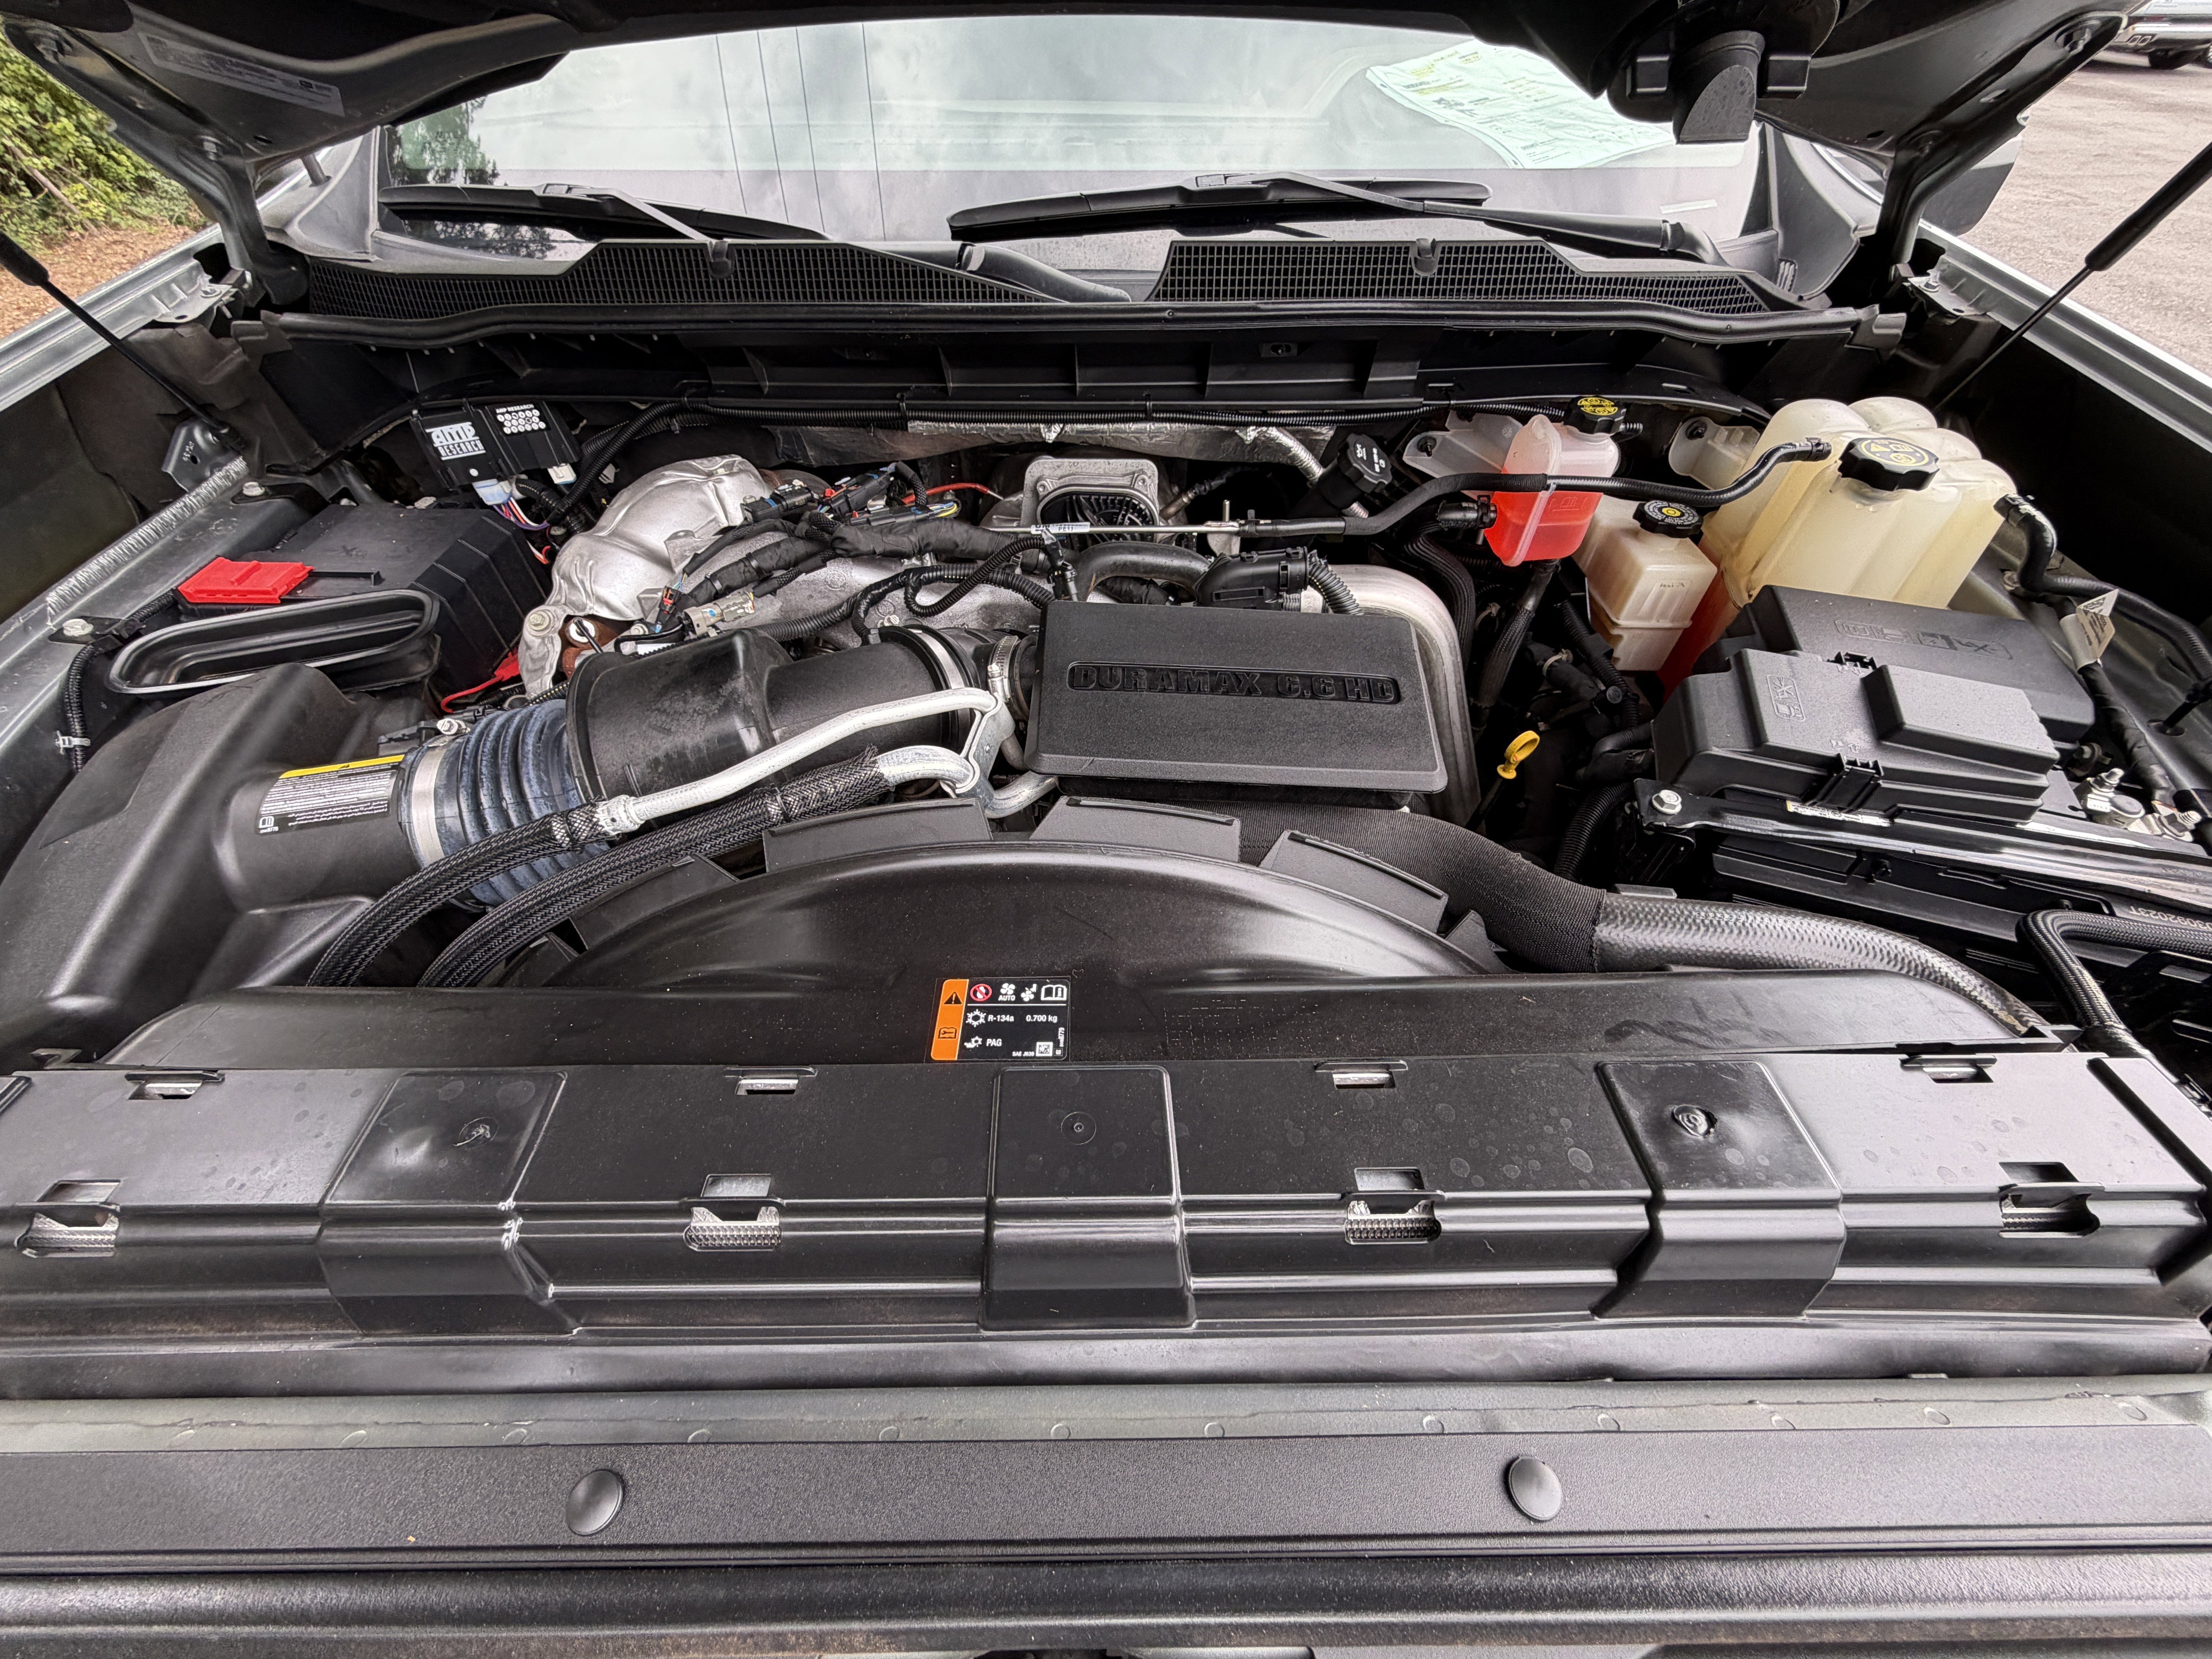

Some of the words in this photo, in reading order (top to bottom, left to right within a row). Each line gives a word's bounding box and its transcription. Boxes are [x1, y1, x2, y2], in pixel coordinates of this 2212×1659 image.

[431, 424, 476, 446] AMP
[438, 440, 484, 456] RESEARCH
[1073, 666, 1262, 696] DURAMAX
[1278, 674, 1335, 699] 6.6
[1345, 677, 1394, 702] HD
